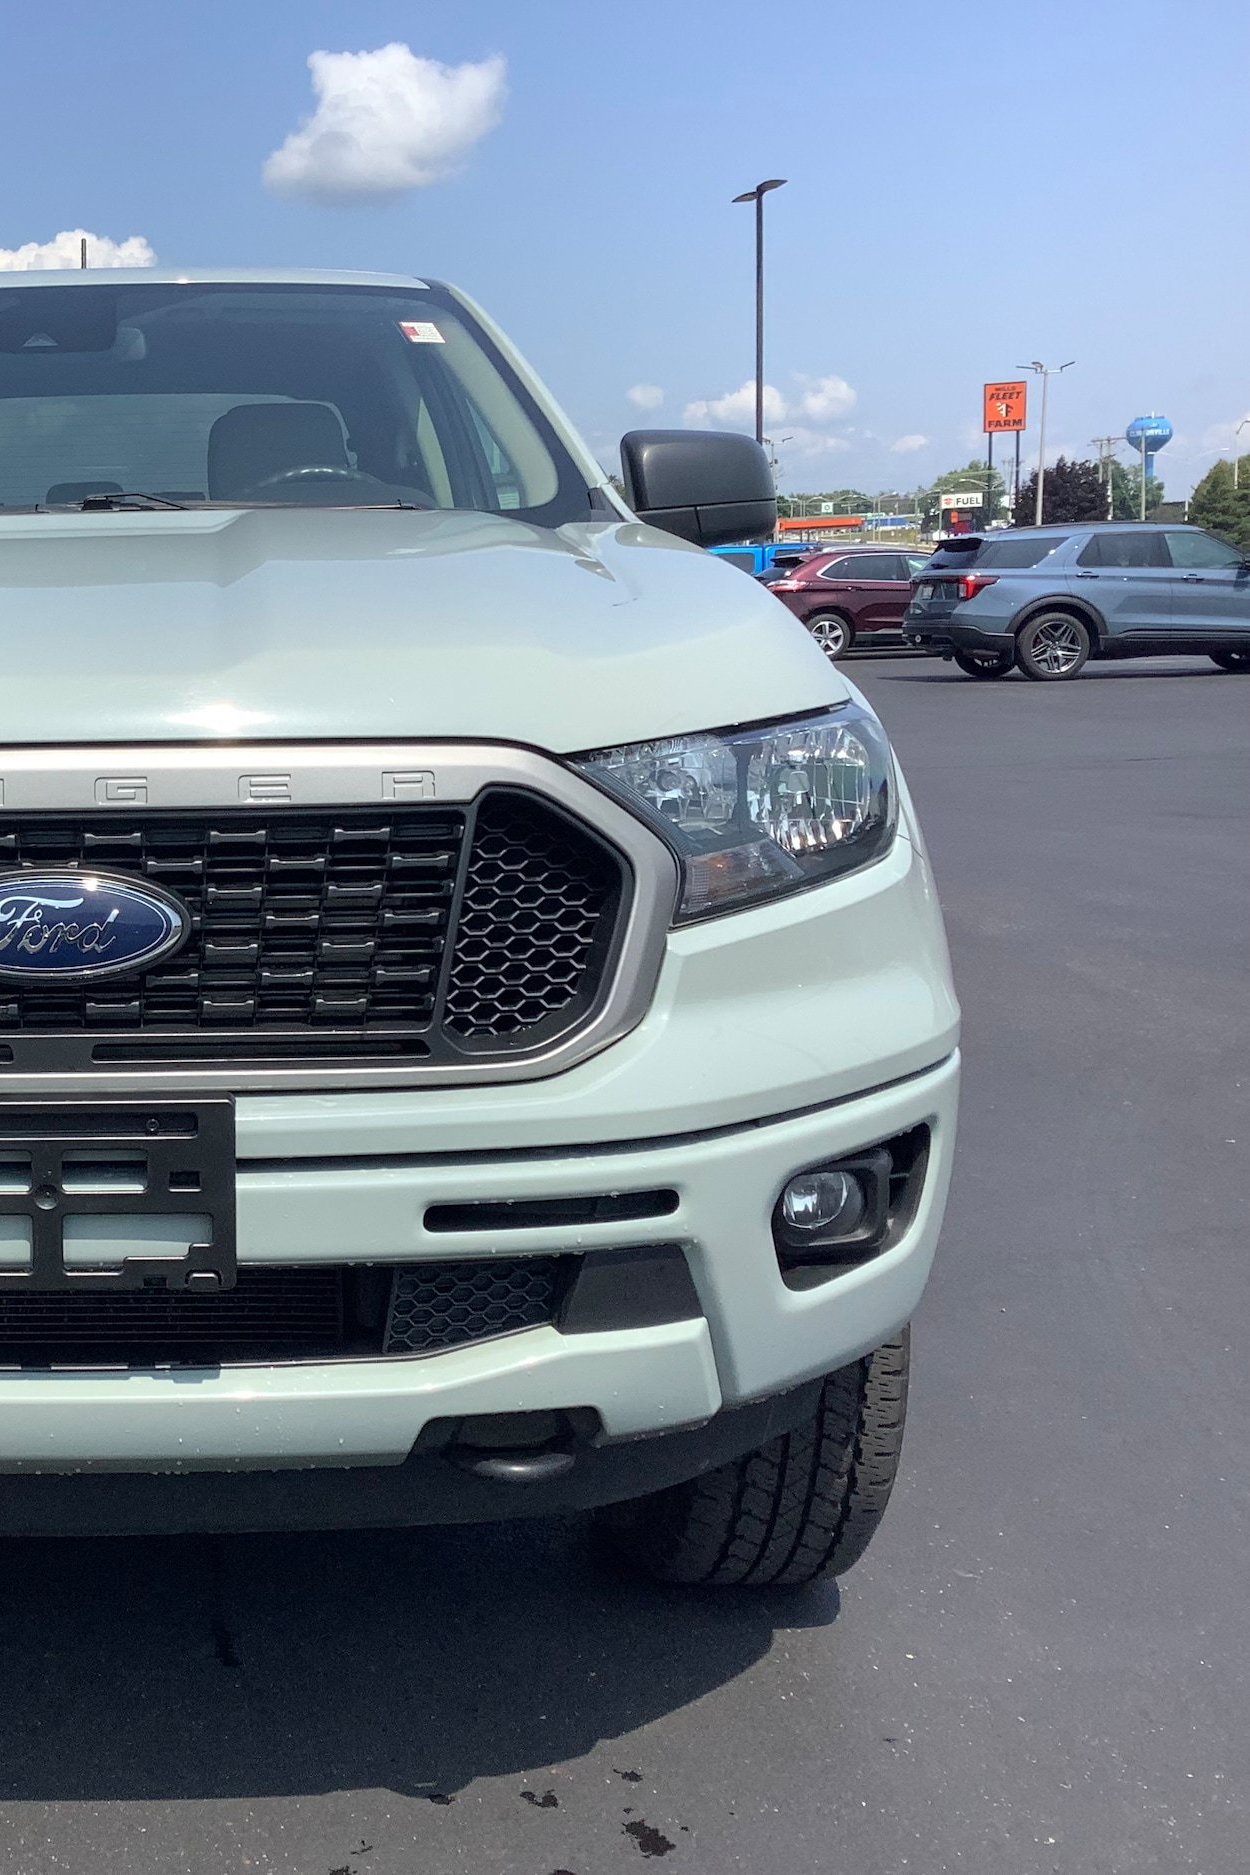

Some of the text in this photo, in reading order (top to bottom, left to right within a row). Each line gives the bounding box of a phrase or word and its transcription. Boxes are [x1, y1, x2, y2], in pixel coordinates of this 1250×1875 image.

[989, 391, 1022, 401] FLEET
[988, 419, 1023, 428] FARM
[956, 496, 981, 506] FUEL
